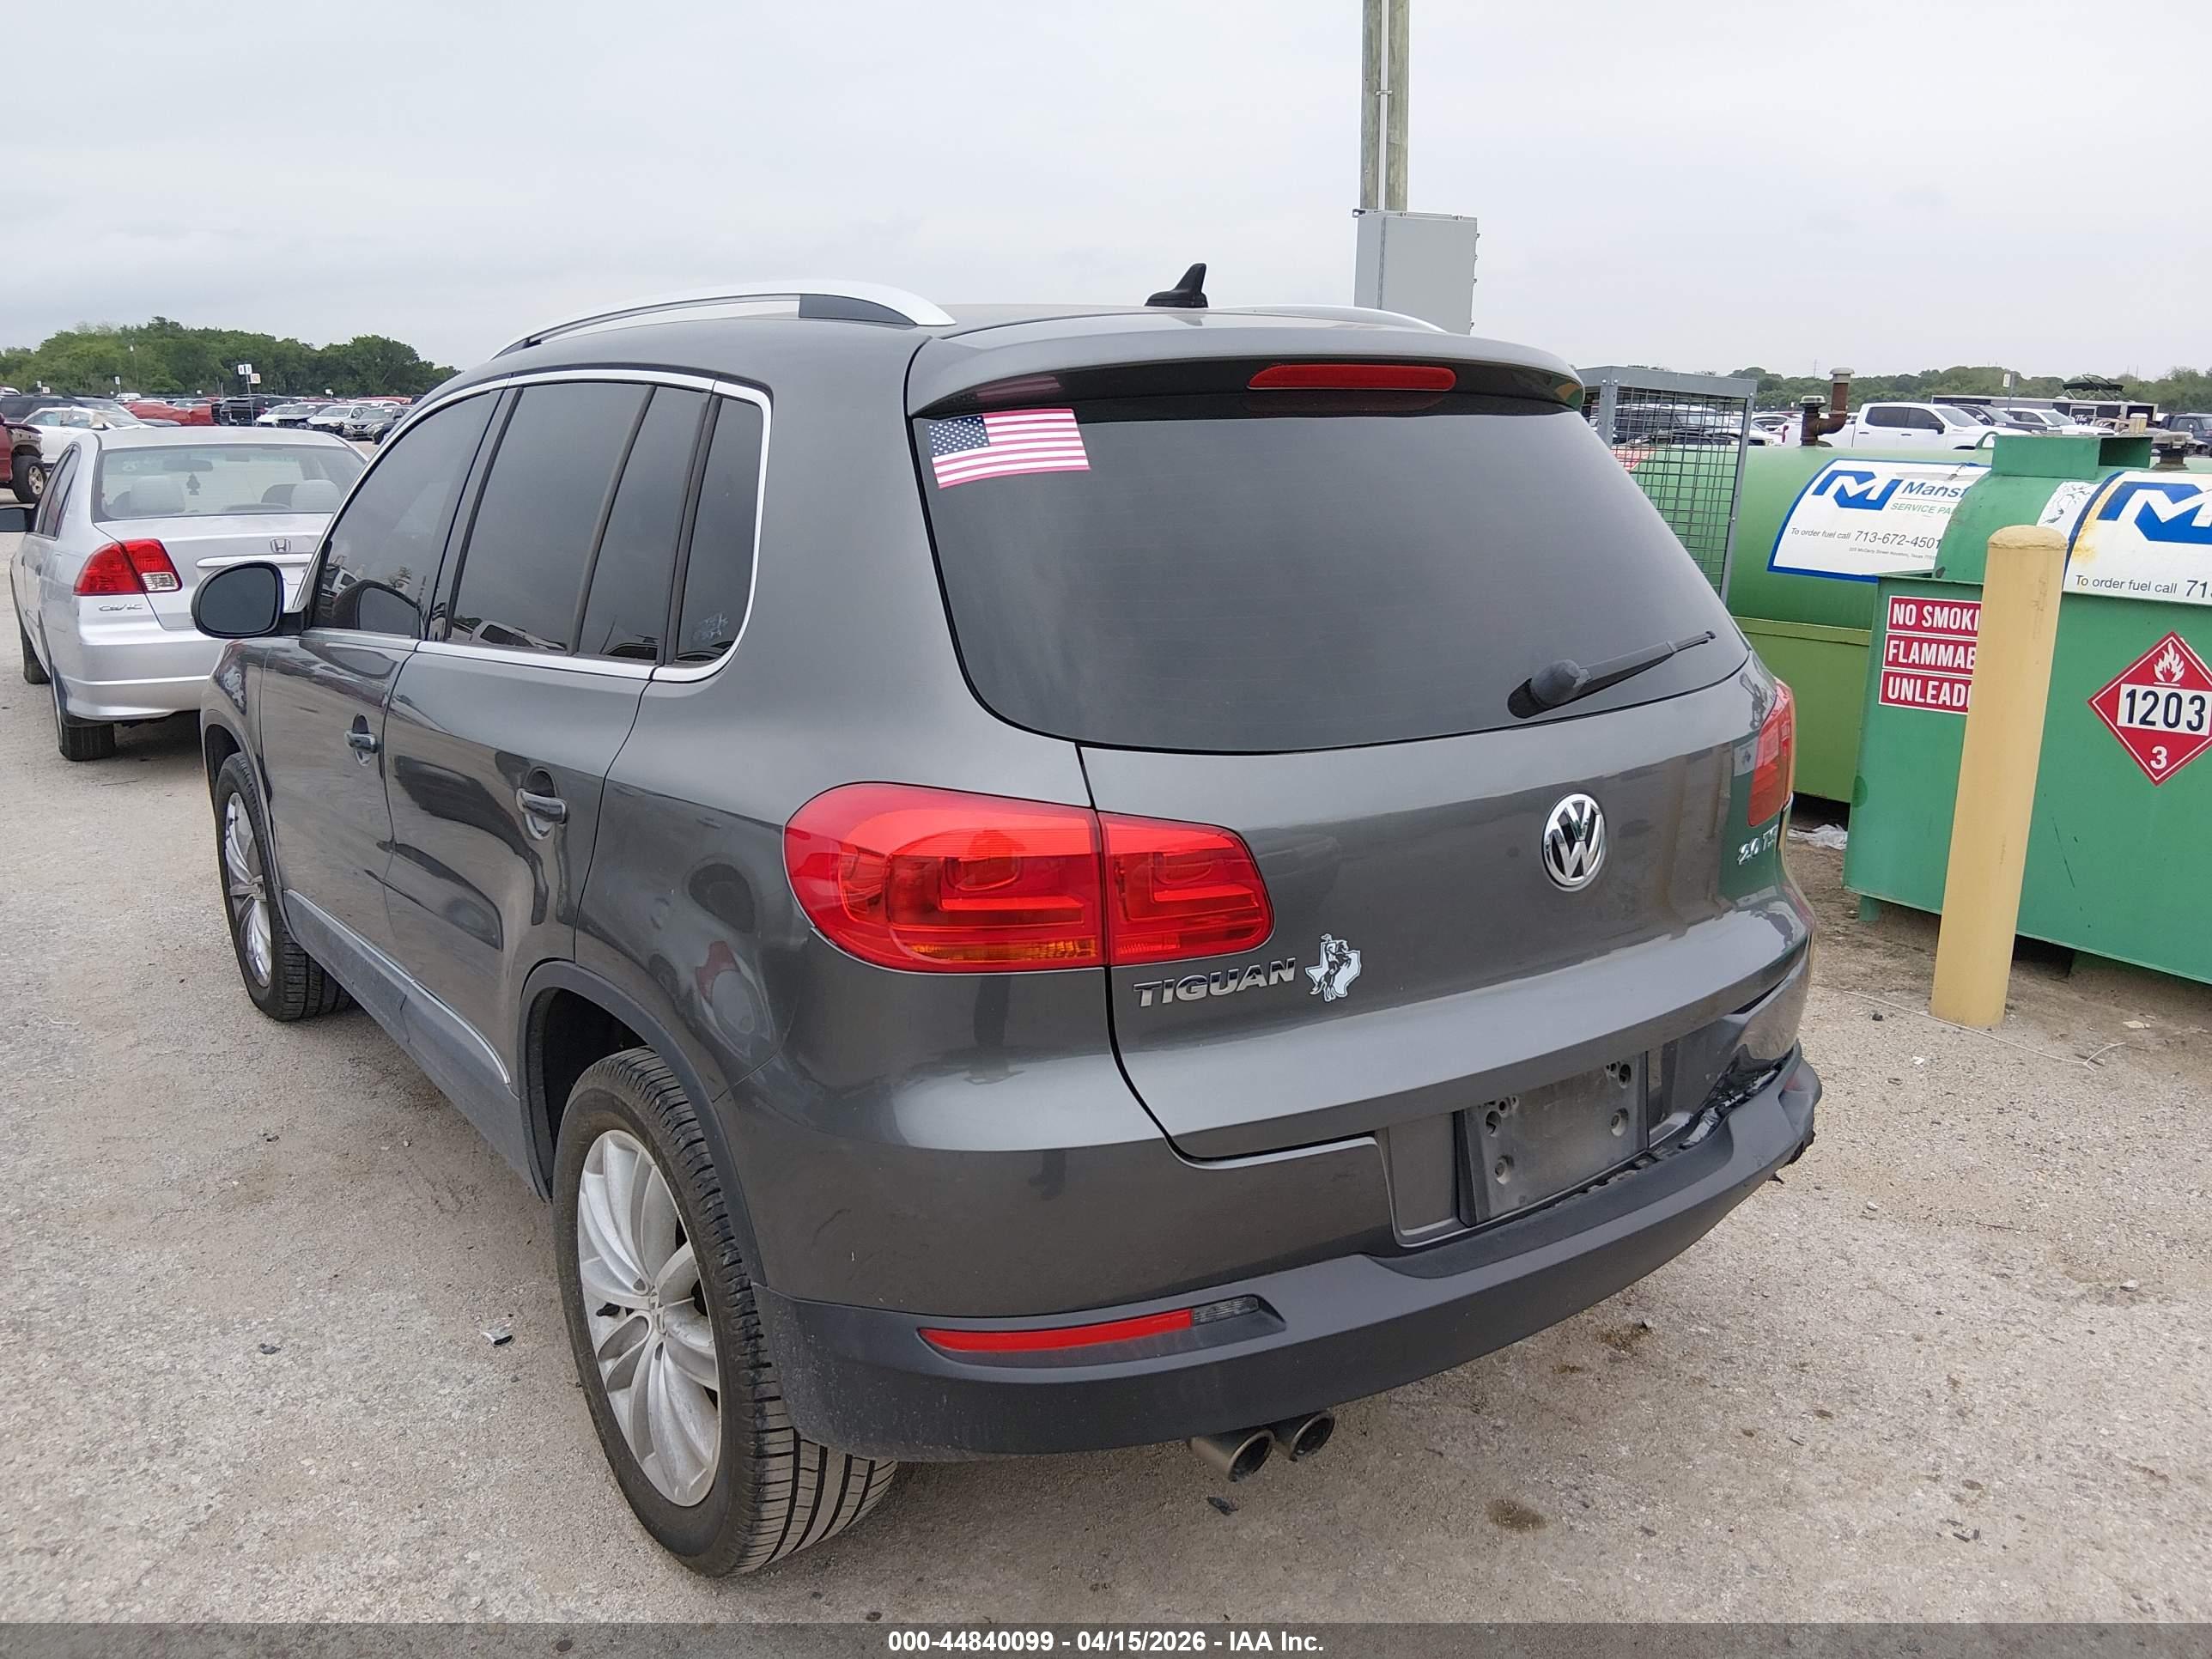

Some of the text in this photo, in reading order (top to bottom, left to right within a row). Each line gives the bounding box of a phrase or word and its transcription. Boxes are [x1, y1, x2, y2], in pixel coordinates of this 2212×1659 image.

[1890, 502, 1954, 515] SERVICE PA
[1822, 530, 1836, 538] fuel
[1855, 531, 1942, 549] 713-672-4501
[2075, 574, 2212, 599] To order fuel call 71
[1892, 603, 1917, 626] NO
[1887, 640, 1977, 670] FLAMMAB
[2125, 688, 2206, 732] 1203
[2149, 745, 2167, 769] 3
[1133, 957, 1297, 1007] TIGUAN
